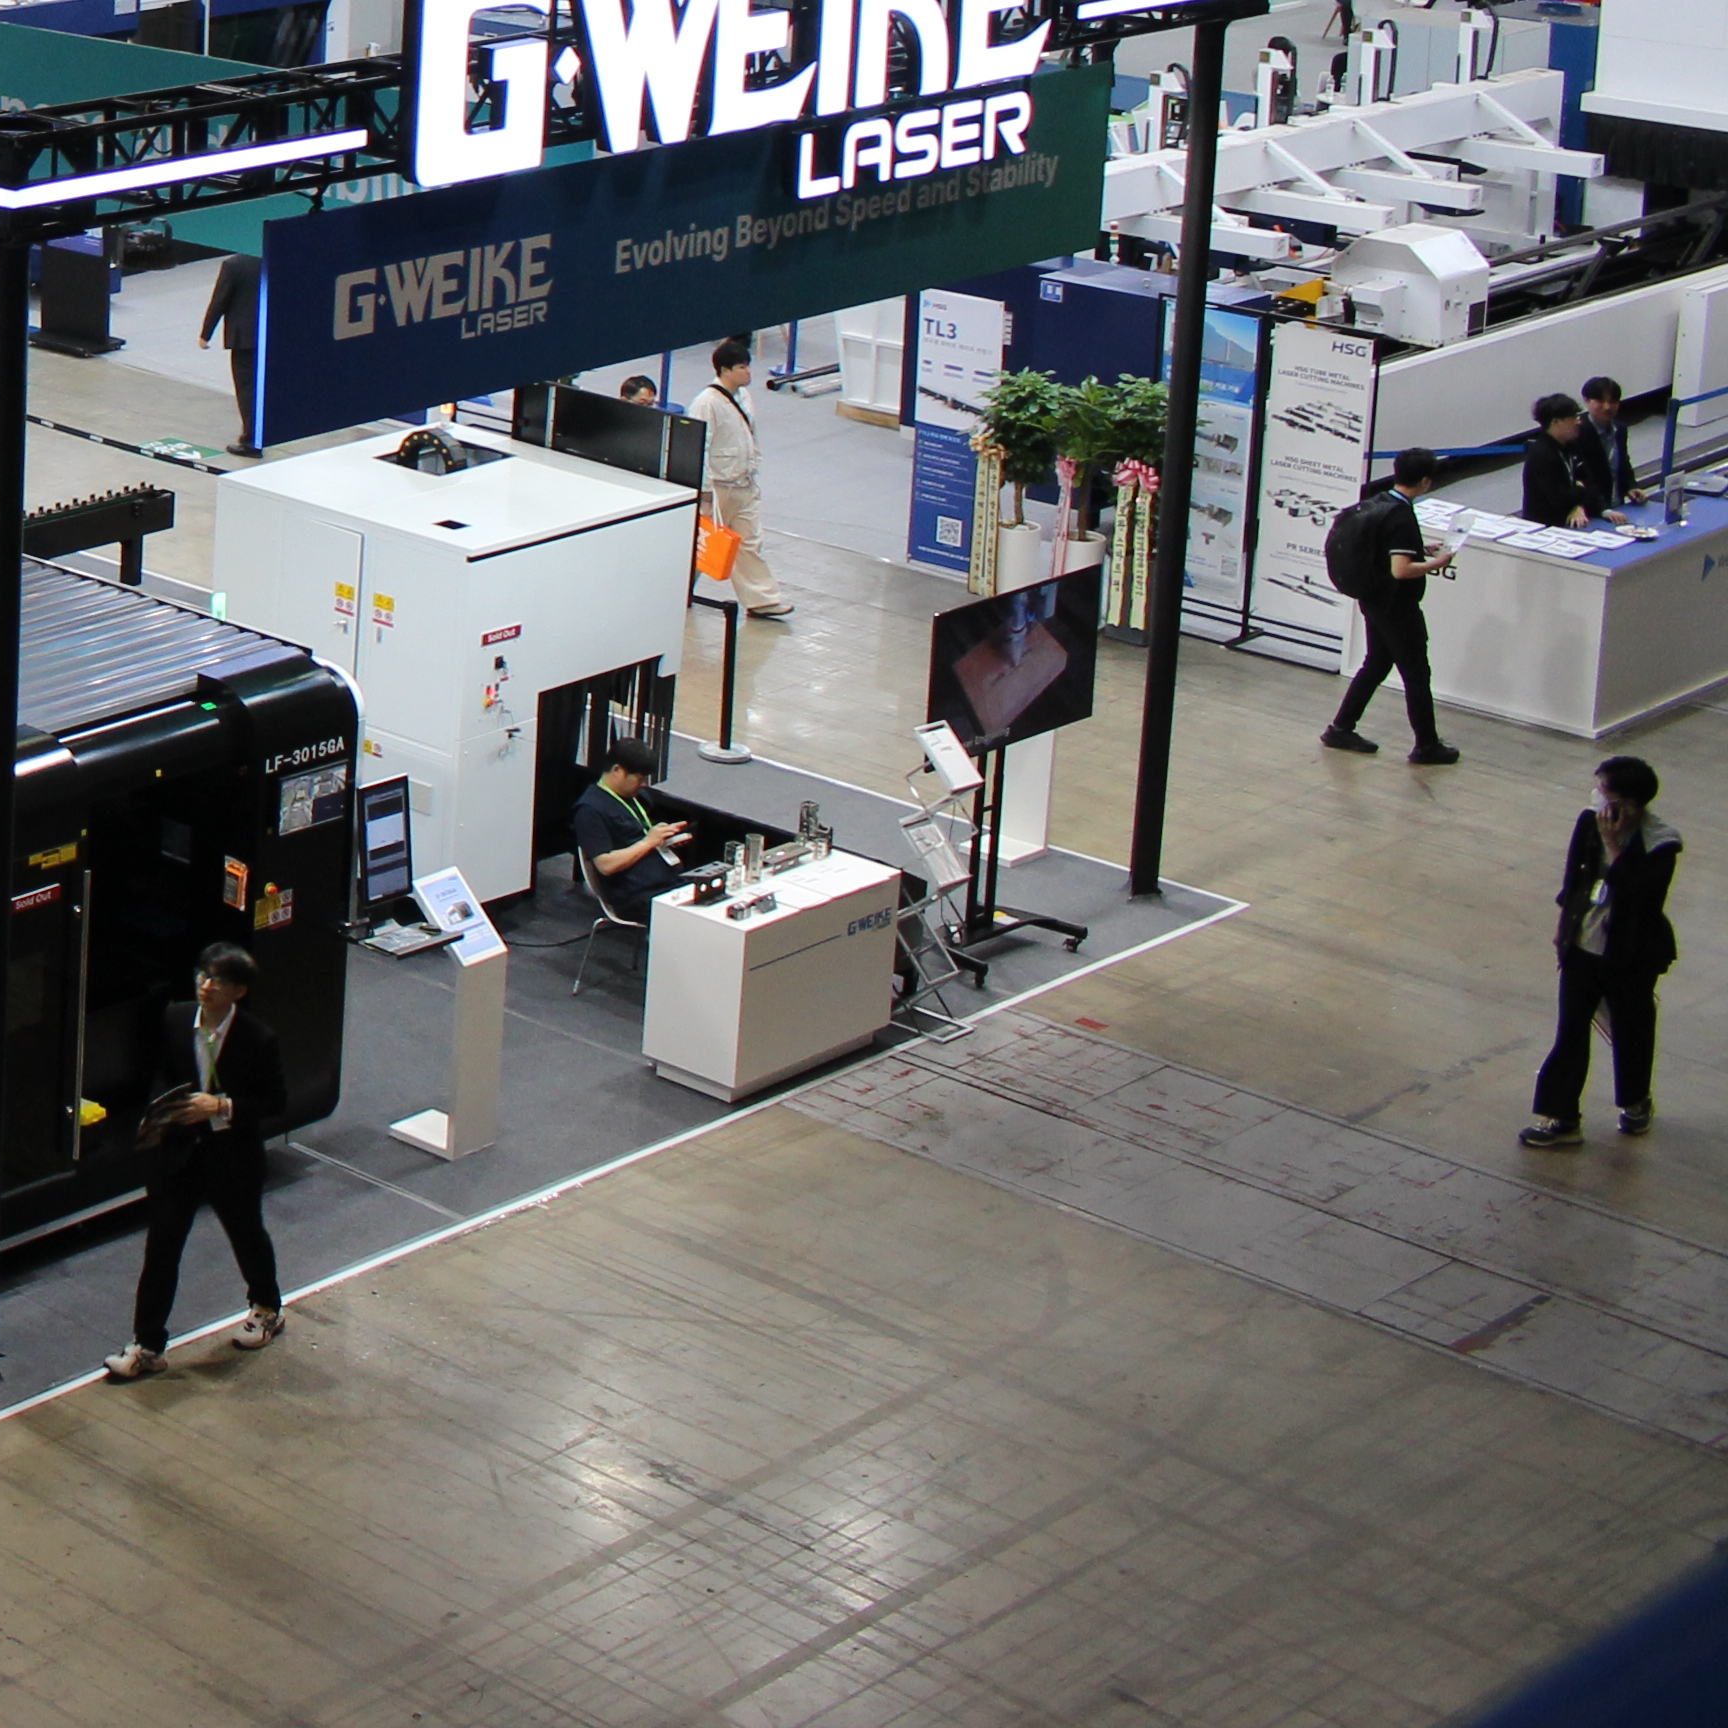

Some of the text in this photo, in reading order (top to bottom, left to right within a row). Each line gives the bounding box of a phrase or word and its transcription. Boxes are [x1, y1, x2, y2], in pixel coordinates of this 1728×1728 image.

[797, 91, 1032, 201] LASER
[614, 152, 1060, 276] Evolving Beyond Speed and Stability
[459, 298, 550, 340] LASER
[923, 317, 958, 340] TL3
[1330, 340, 1368, 359] HSG
[1277, 368, 1298, 379] LASER
[1270, 458, 1292, 469] LASER
[264, 735, 346, 775] LF-3015GA
[15, 890, 52, 911] Sold Out
